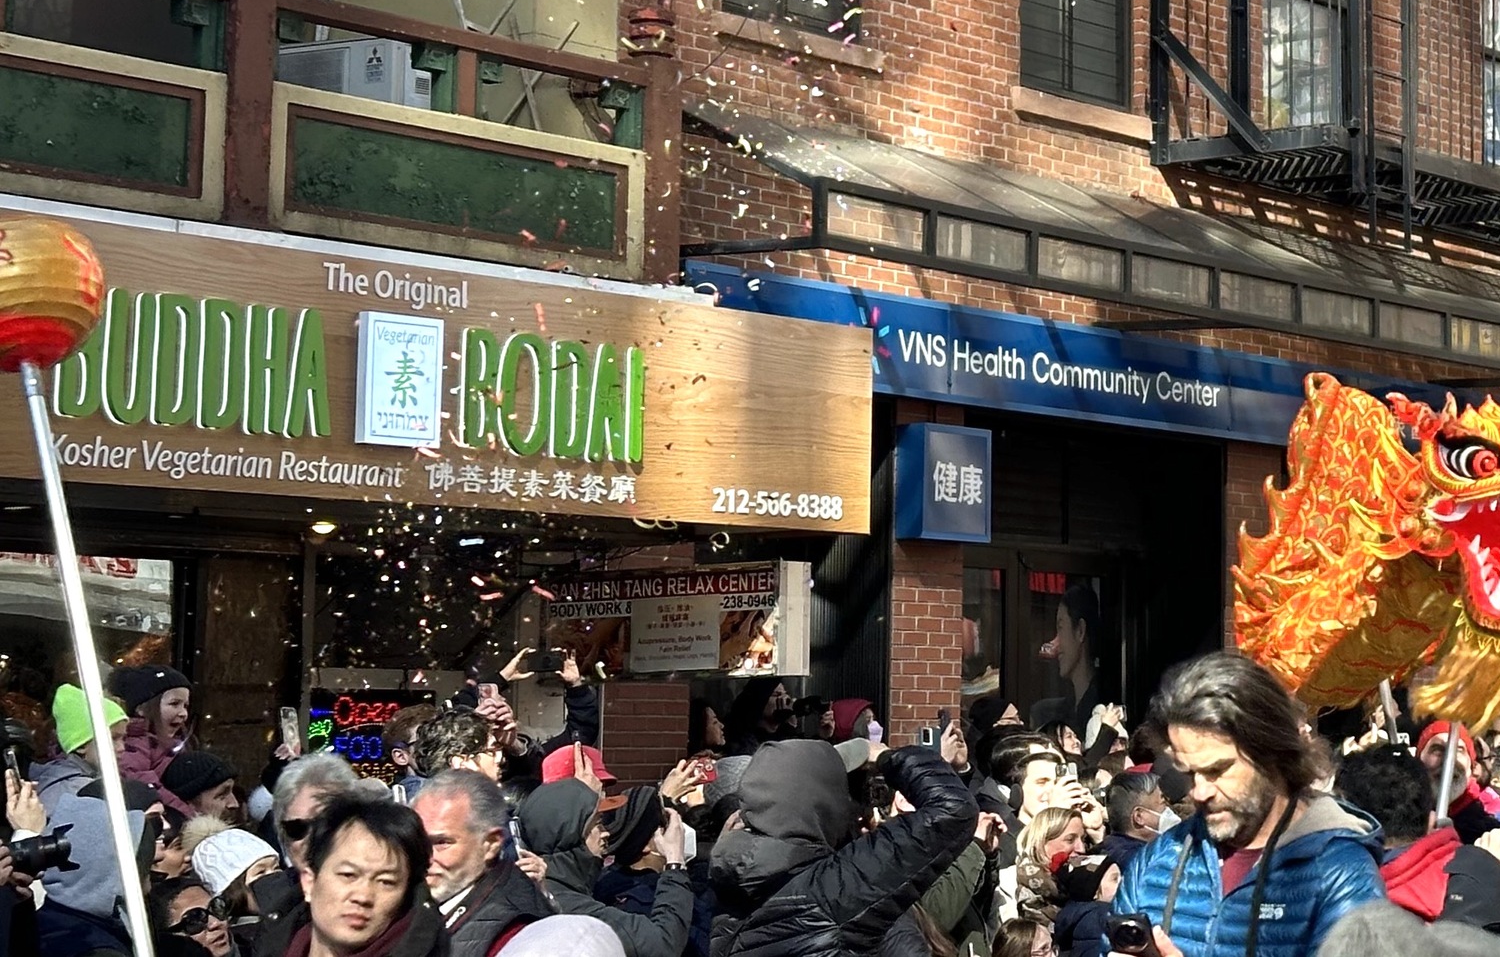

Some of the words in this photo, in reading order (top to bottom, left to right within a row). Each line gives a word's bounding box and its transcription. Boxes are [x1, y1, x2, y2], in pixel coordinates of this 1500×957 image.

[323, 261, 369, 296] The
[374, 269, 468, 311] Original
[376, 325, 435, 346] Vegetarian
[384, 350, 425, 409] 素
[898, 329, 947, 368] VNS
[953, 339, 1026, 380] Health
[1031, 351, 1151, 404] Community
[1156, 371, 1221, 407] Center
[48, 432, 137, 470] Kosher
[141, 439, 272, 480] Vegetarian
[279, 450, 404, 489] Restaurant
[711, 487, 843, 521] 212-566-8388
[933, 461, 983, 506] 健康
[551, 583, 579, 601] SAN
[583, 579, 621, 600] ZHEN
[624, 577, 663, 598] TANG
[666, 575, 715, 595] RELAX
[718, 571, 776, 593] CENTER
[550, 602, 583, 618] BODY
[585, 600, 622, 616] WORK
